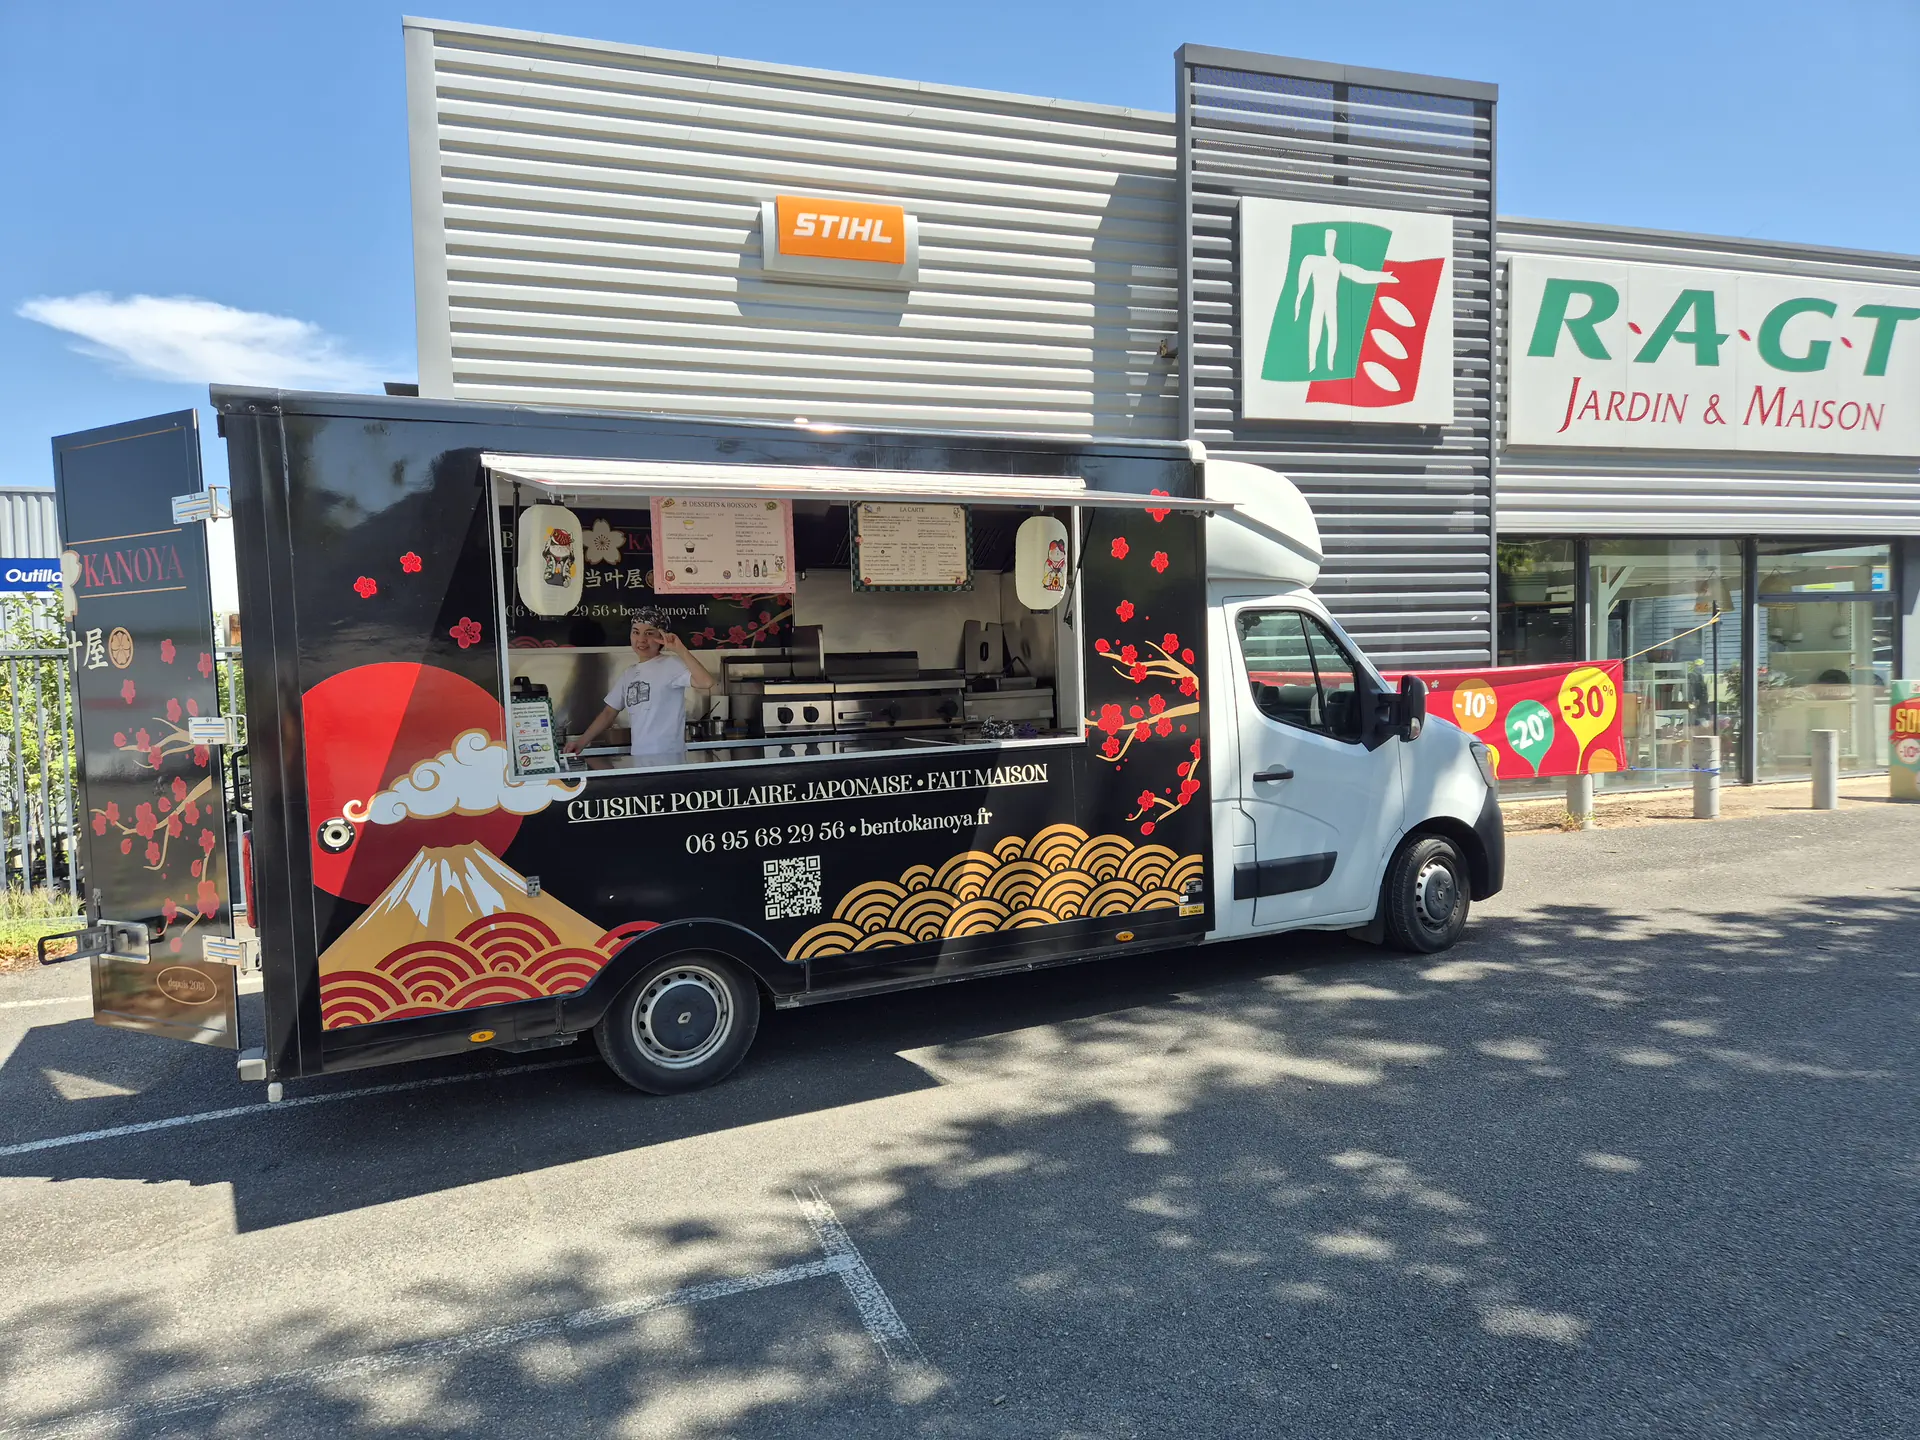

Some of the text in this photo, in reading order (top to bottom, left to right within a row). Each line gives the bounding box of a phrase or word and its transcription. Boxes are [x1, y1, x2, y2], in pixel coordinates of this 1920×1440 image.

[793, 212, 892, 243] STIHL
[1703, 394, 1726, 425] &
[83, 545, 185, 588] KANOYA
[572, 605, 589, 616] 29
[592, 604, 609, 616] 56
[1455, 691, 1495, 718] -10%
[1564, 685, 1613, 719] -30%
[1511, 709, 1550, 750] -20%
[568, 763, 1048, 821] CUISINE POPULAIRE JAPONAISE FAIT MAISON
[686, 807, 993, 854] 06 95 68 29 56 bentokanoya.fr
